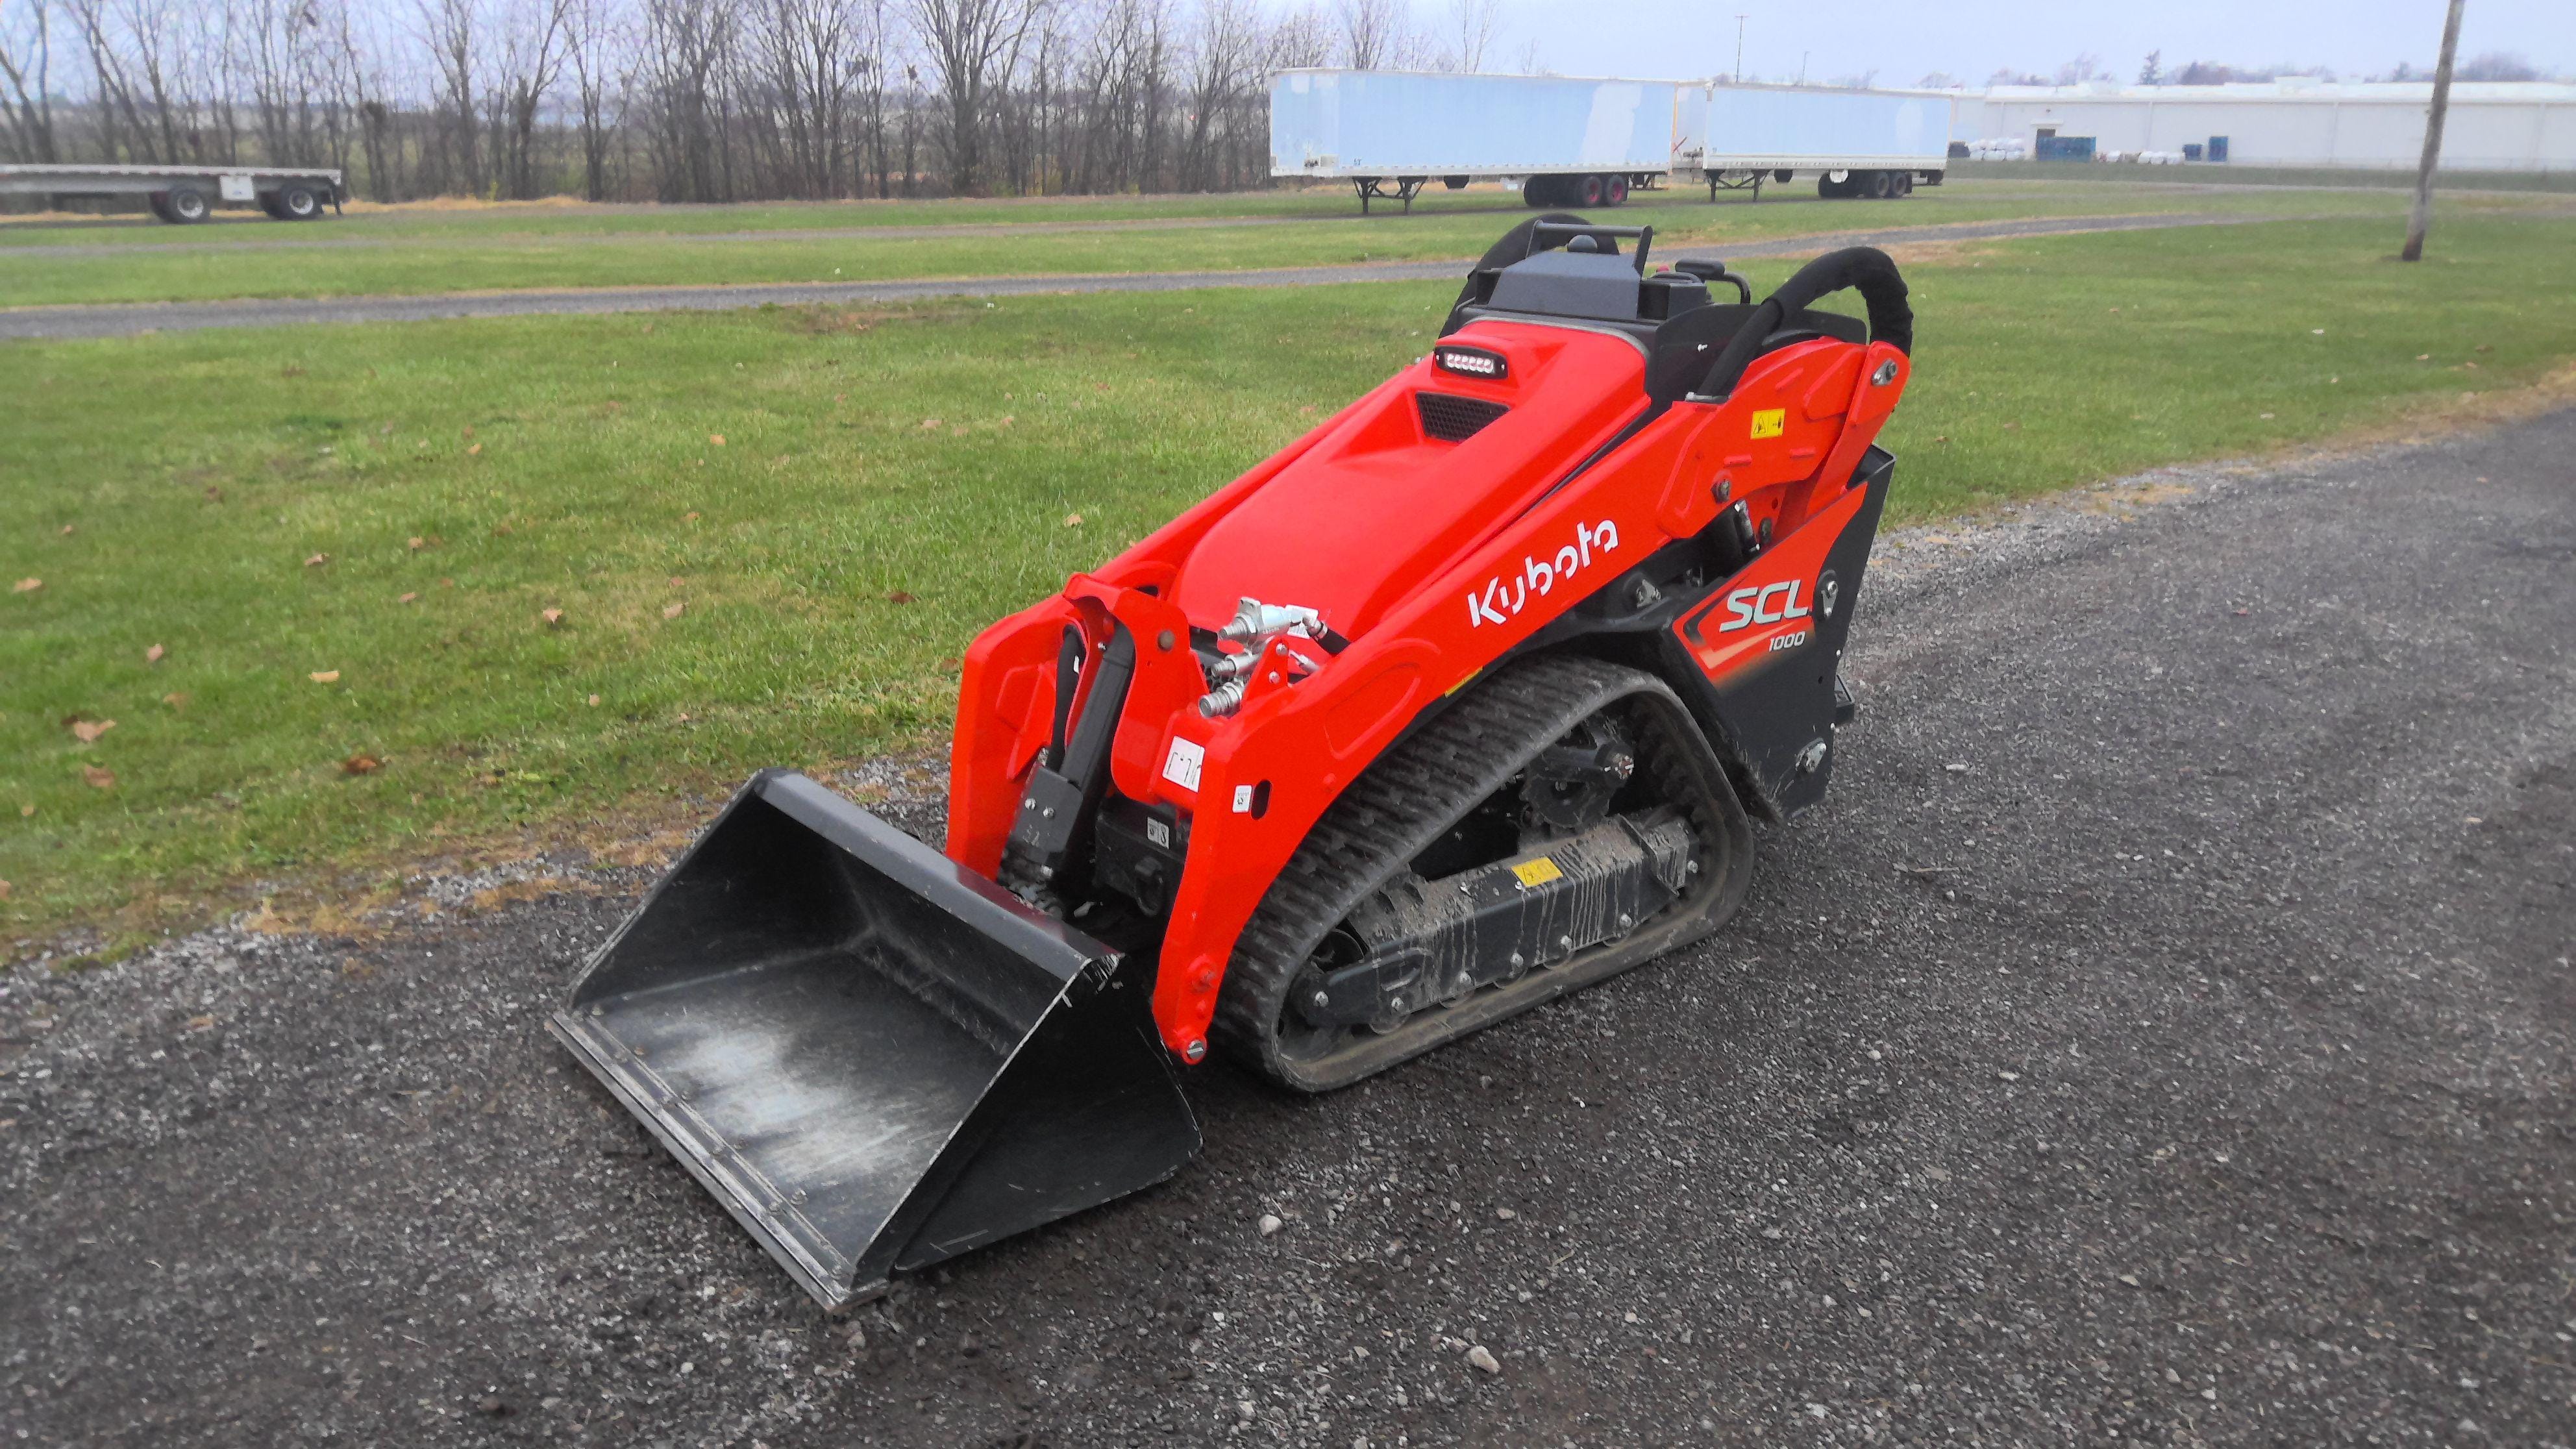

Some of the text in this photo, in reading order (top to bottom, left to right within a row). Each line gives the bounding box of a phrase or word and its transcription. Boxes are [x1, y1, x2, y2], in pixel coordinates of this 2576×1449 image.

[1468, 519, 1618, 627] Kubota
[1720, 580, 1809, 632] SCL
[1769, 631, 1805, 652] 1000
